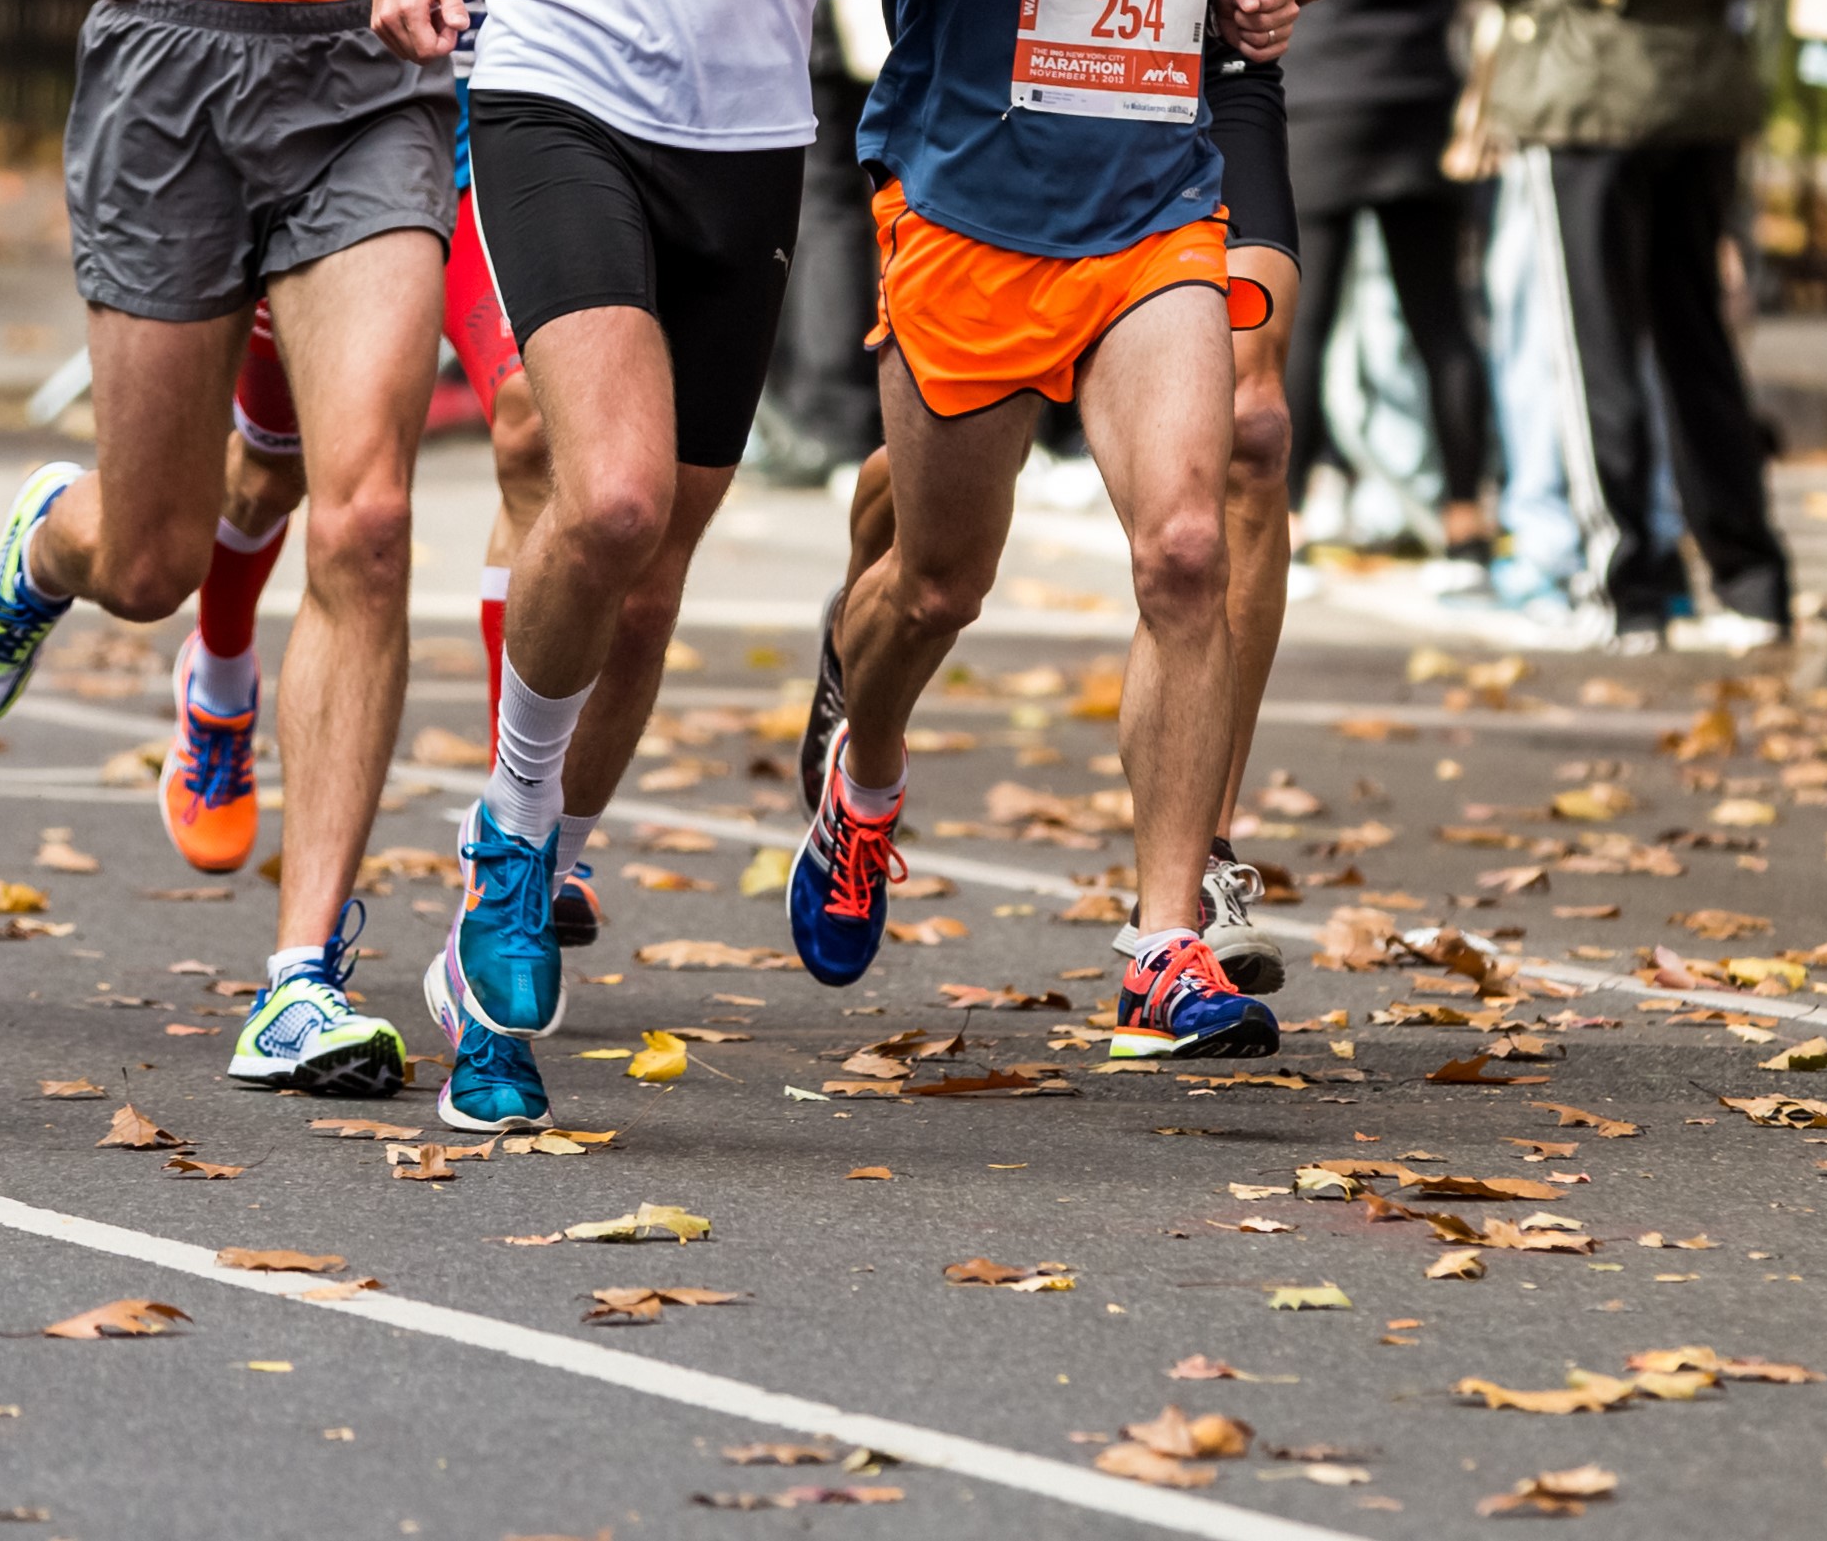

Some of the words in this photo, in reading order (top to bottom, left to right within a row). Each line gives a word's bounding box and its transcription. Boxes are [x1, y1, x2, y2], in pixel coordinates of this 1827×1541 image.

[1032, 47, 1048, 56] THE
[1066, 50, 1085, 59] NEW
[1086, 52, 1107, 61] YORK
[1108, 54, 1125, 62] CITY
[1030, 55, 1125, 75] MARATHON
[1029, 68, 1086, 81] NOVEMBER
[1090, 74, 1099, 83] 3,
[1102, 75, 1124, 84] 2013
